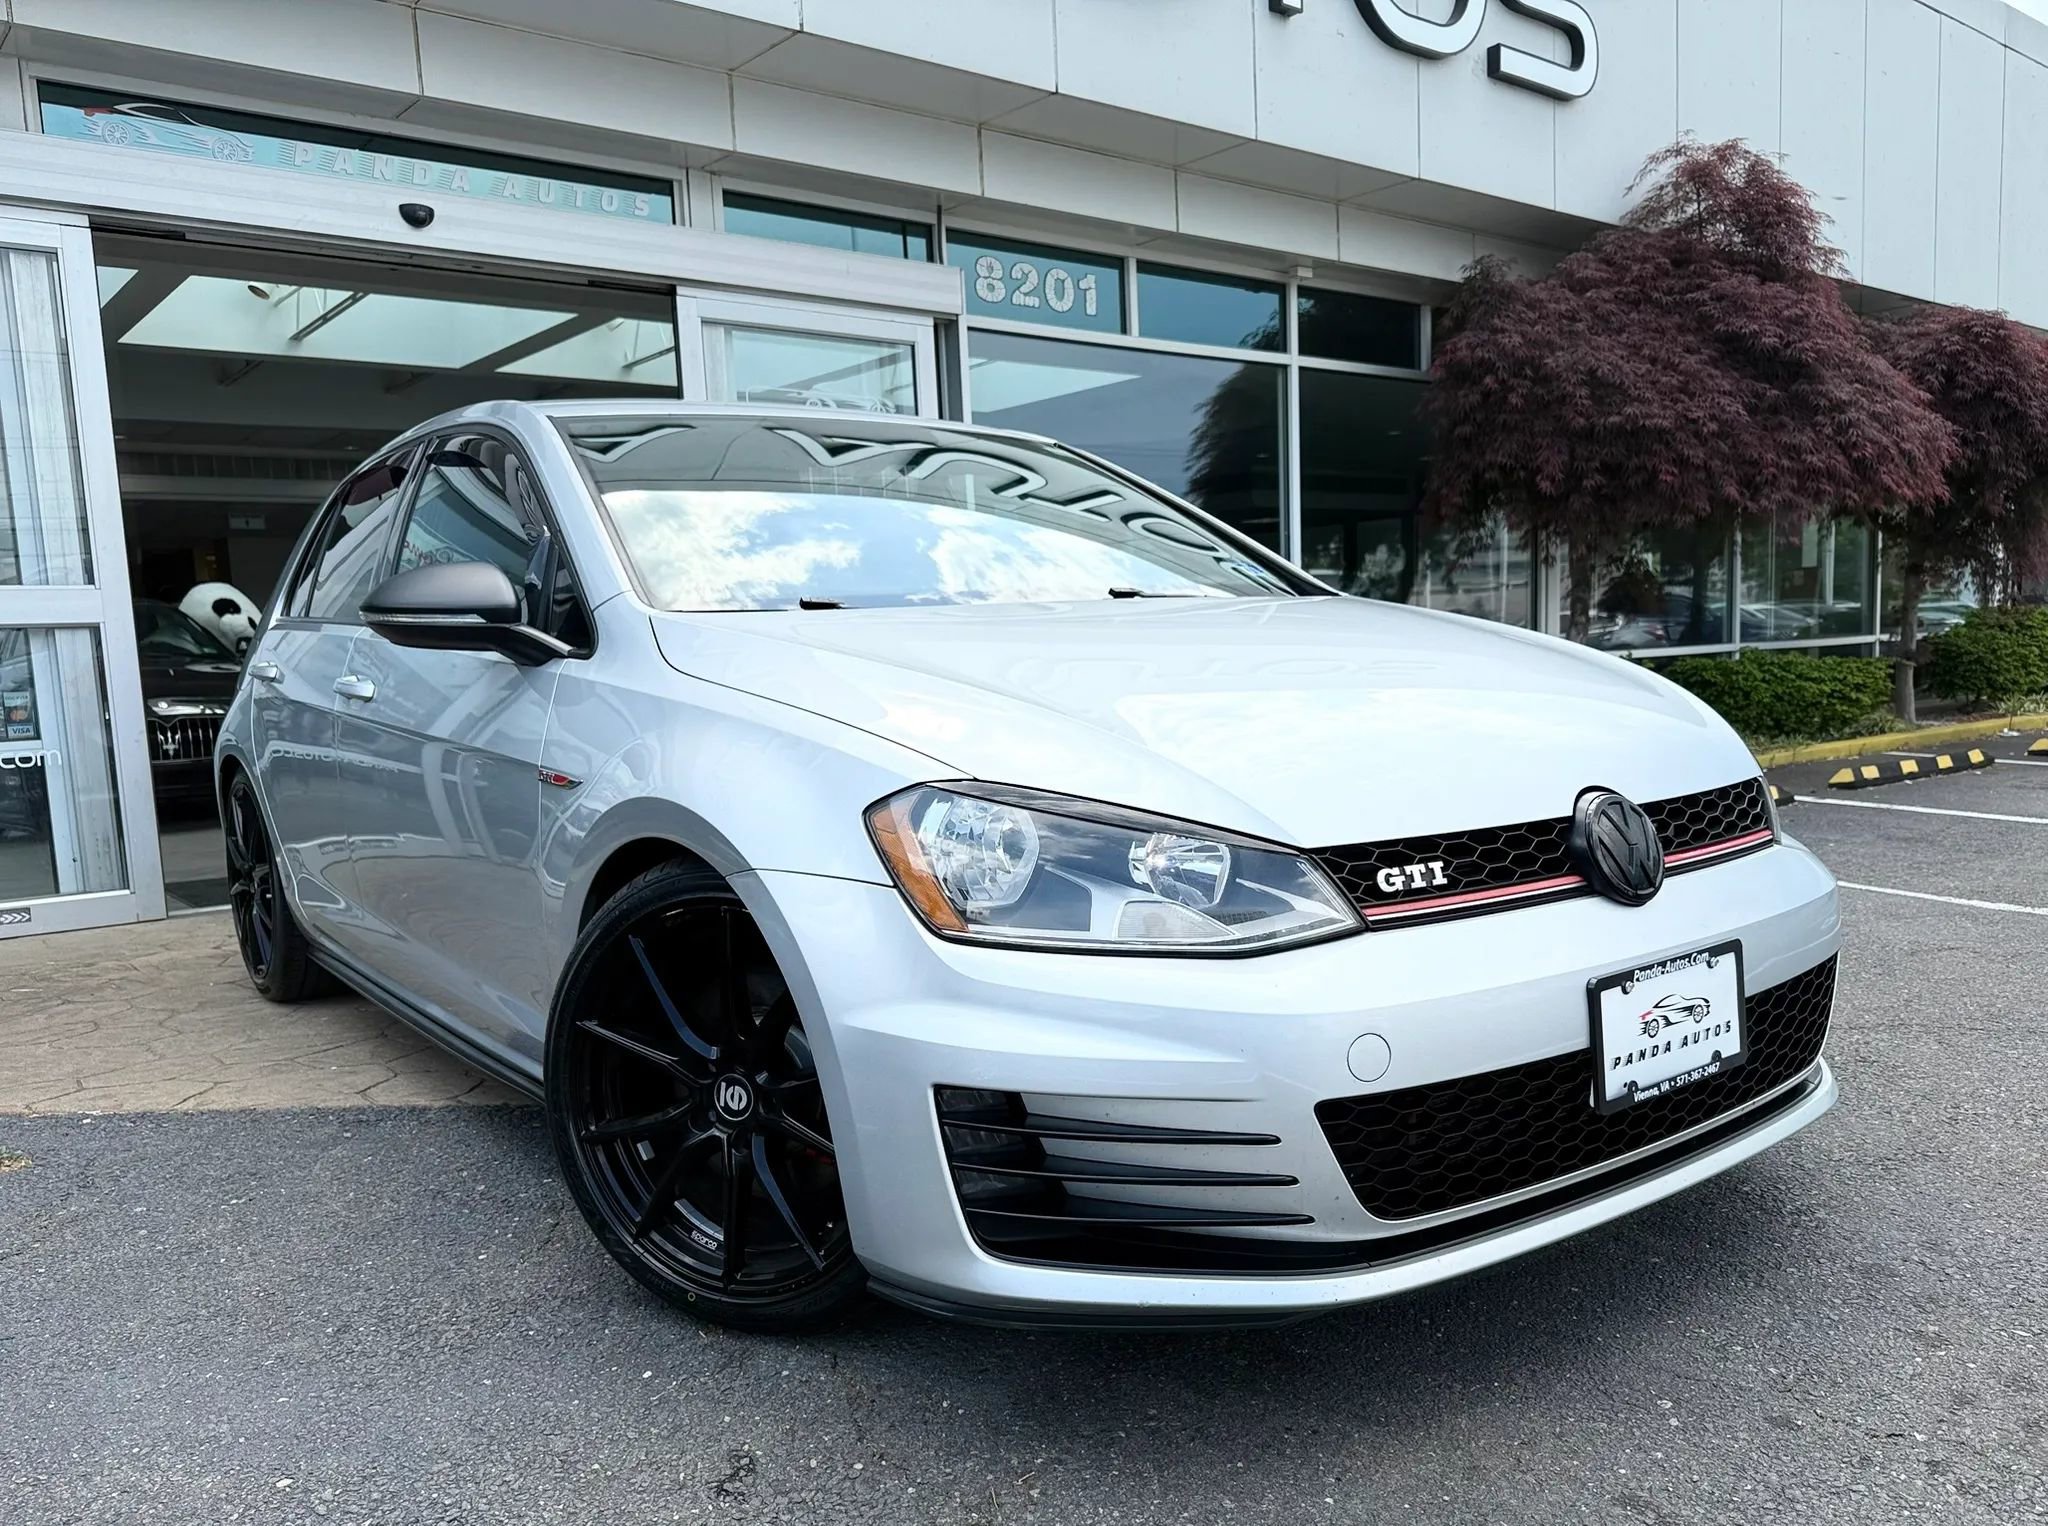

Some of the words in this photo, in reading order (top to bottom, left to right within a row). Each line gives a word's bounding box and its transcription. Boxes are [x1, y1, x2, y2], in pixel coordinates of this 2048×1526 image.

[293, 147, 471, 193] PANDA
[502, 176, 651, 217] AUTOS
[975, 255, 1097, 316] 8201
[12, 726, 31, 735] VISA
[1377, 860, 1448, 893] GTI
[1633, 951, 1710, 982] Panda-Autos.Com
[1612, 1040, 1672, 1071] PANDA
[1681, 1019, 1731, 1049] AUTOS
[1660, 1080, 1671, 1094] VA
[1675, 1061, 1721, 1087] 571-367-2467
[690, 1230, 718, 1250] sparco
